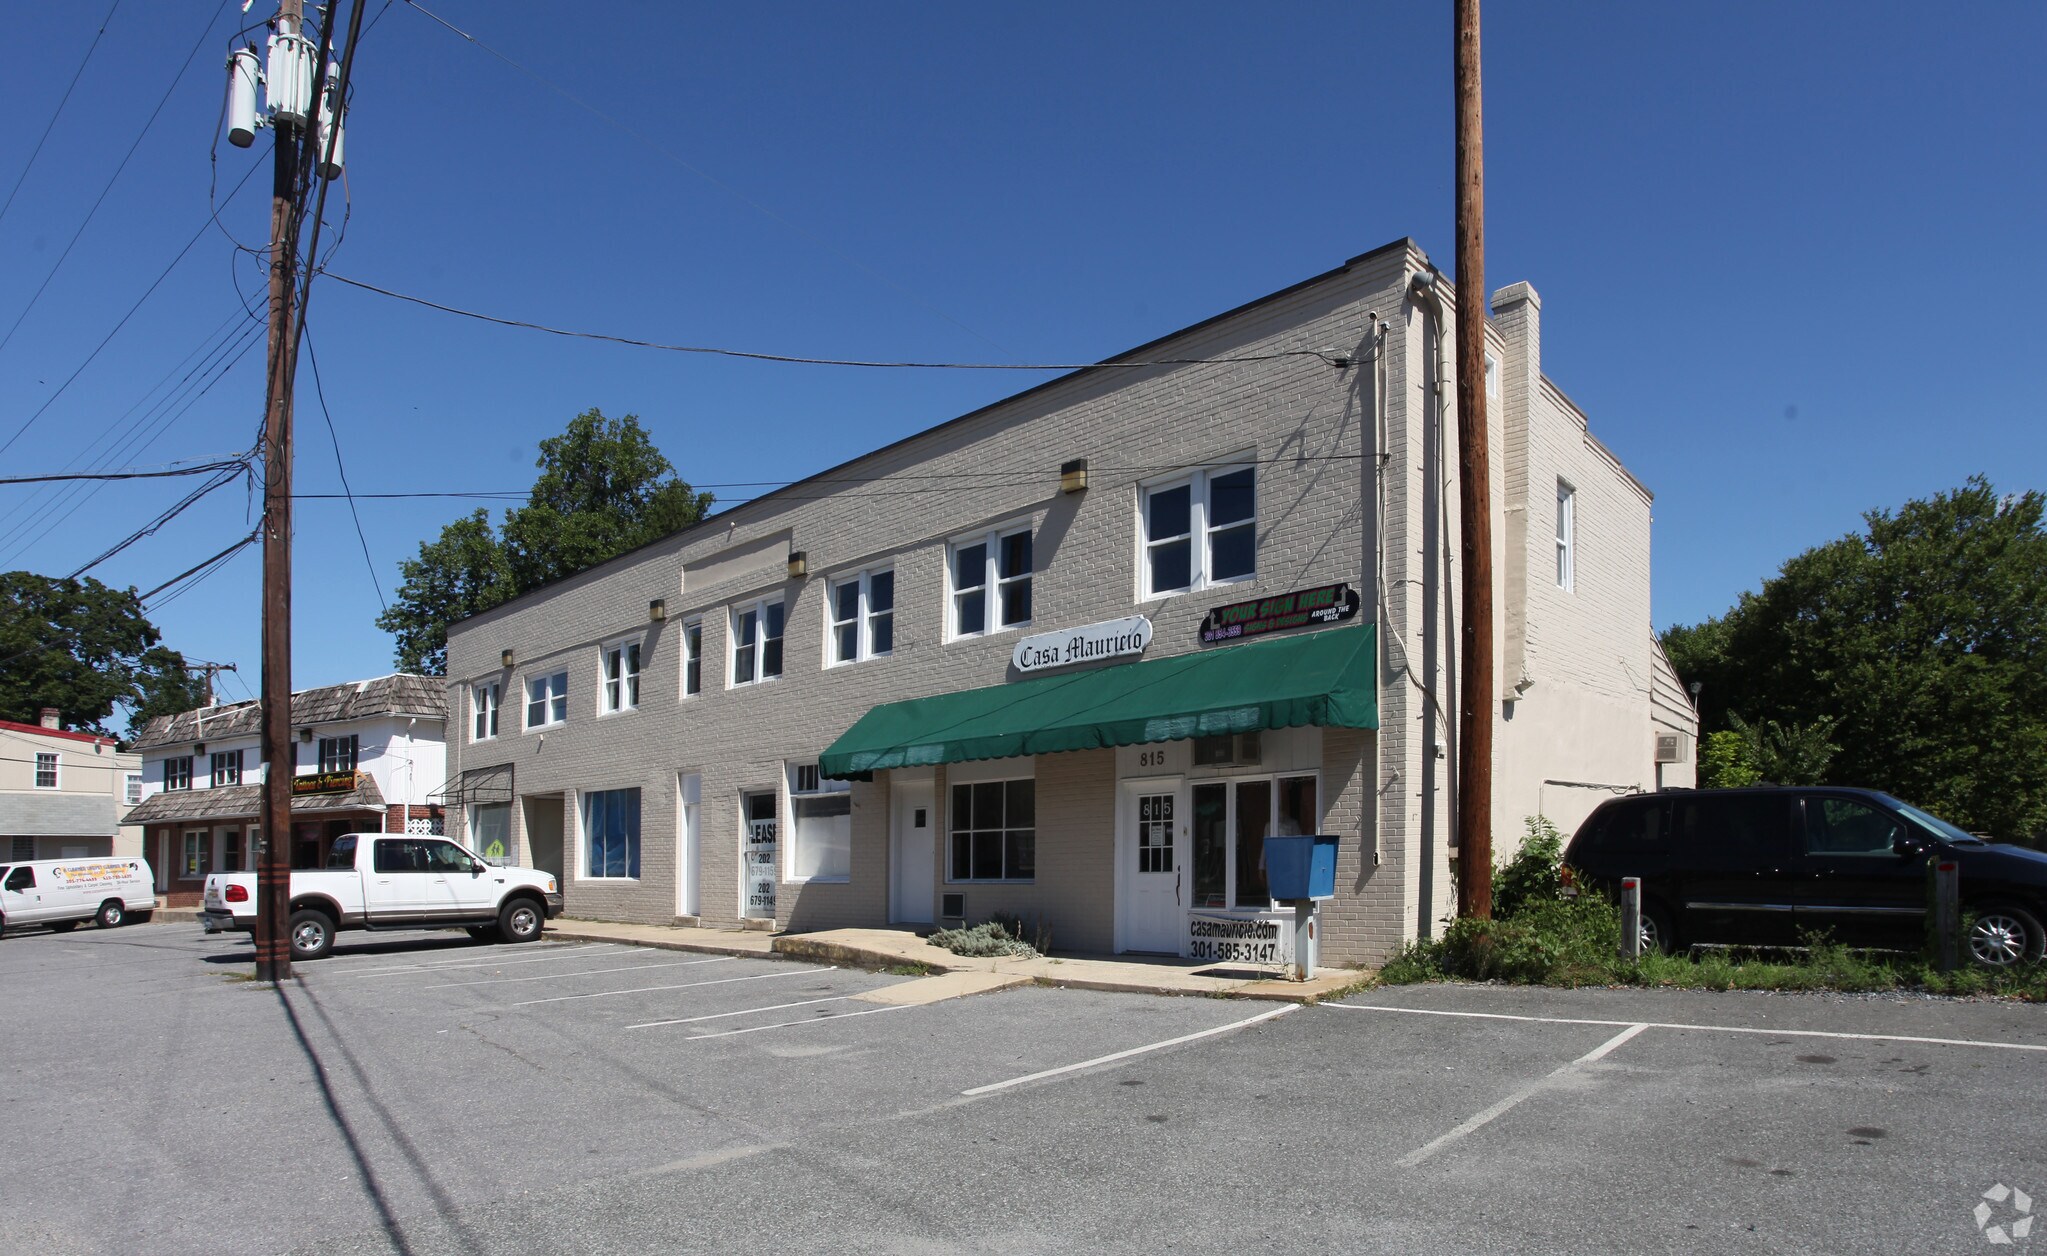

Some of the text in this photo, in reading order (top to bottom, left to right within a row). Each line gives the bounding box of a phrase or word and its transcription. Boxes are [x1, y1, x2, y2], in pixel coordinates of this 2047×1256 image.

[1221, 586, 1336, 624] YOUR SIGN HERE
[1311, 605, 1350, 618] AROUND THE
[1244, 621, 1267, 632] SIGNS
[1276, 613, 1309, 627] DESIGNS
[1323, 613, 1340, 622] BACK
[1020, 628, 1142, 668] Casa Mauricio
[1140, 750, 1165, 767] 815
[1143, 802, 1171, 816] 815
[758, 853, 771, 864] 202
[758, 882, 770, 893] 202
[1190, 920, 1278, 939] casamauricio.com
[1190, 940, 1276, 961] 301-585-3147
